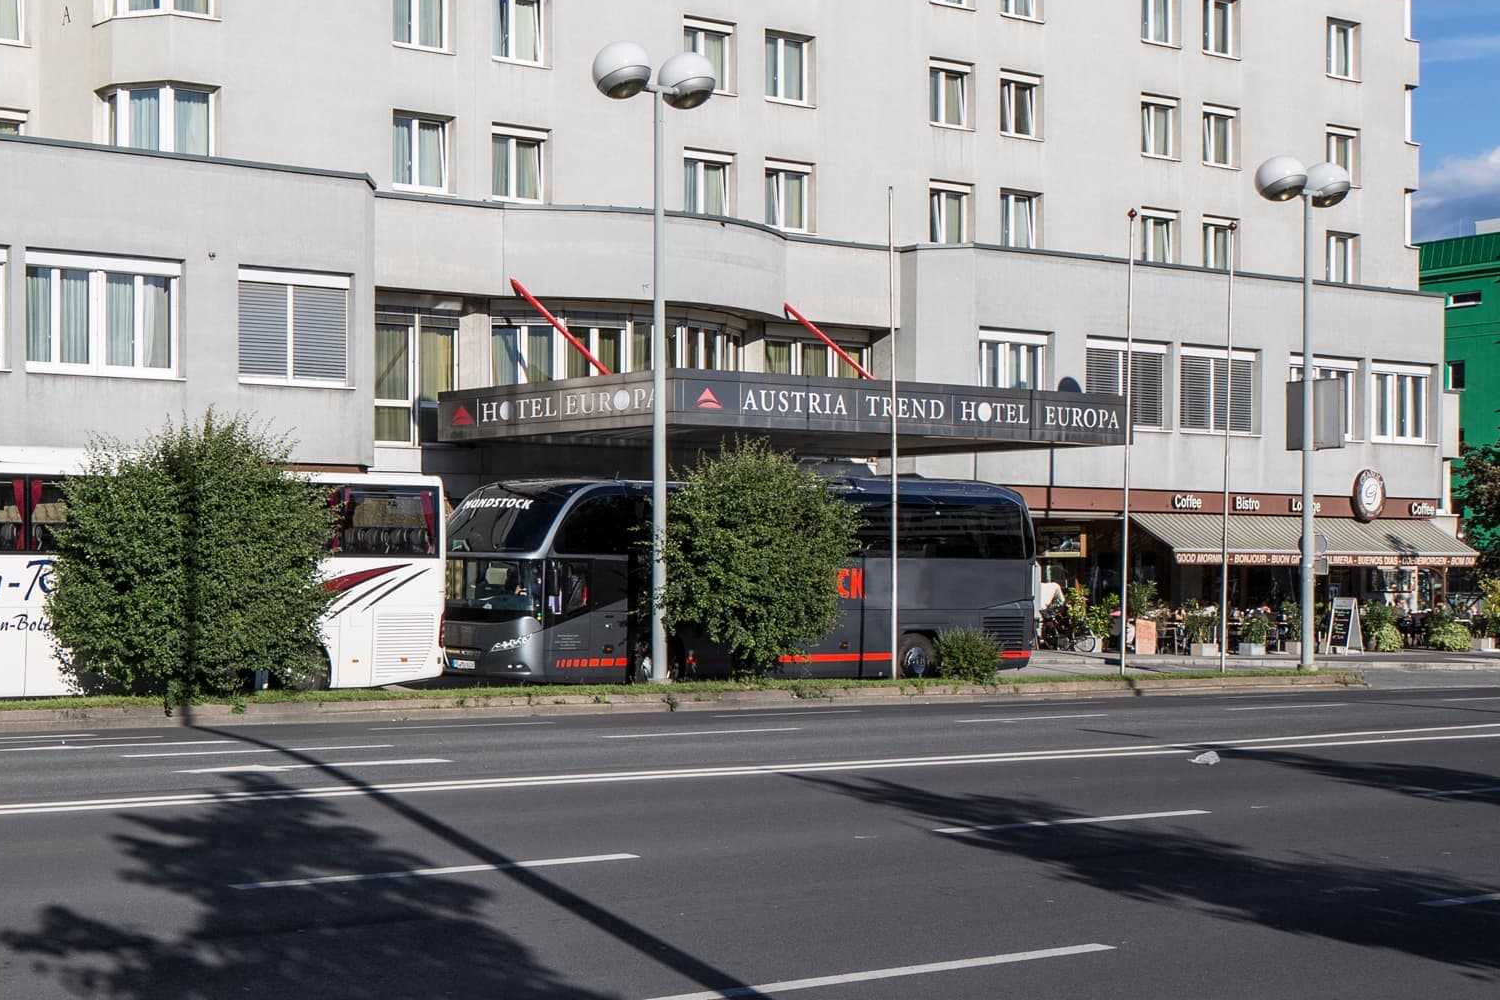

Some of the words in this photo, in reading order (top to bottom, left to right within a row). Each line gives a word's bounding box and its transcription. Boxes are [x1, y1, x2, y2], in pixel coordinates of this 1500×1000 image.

[481, 396, 557, 422] HOTEL
[742, 389, 848, 415] AUSTRIA
[865, 394, 945, 420] TREND
[960, 401, 1030, 424] HOTEL
[1045, 406, 1120, 429] EUROPA
[1174, 494, 1202, 509] Coffee
[1235, 496, 1260, 510] Bistro
[1292, 498, 1321, 513] Loge
[1411, 502, 1435, 516] Coffee
[1176, 553, 1197, 563] GOOD
[1197, 553, 1229, 563] MORNIN
[1234, 554, 1267, 563] BONJOUR
[1271, 554, 1290, 564] BUON
[1358, 556, 1383, 565] BUENOS
[1383, 556, 1398, 565] DIAS
